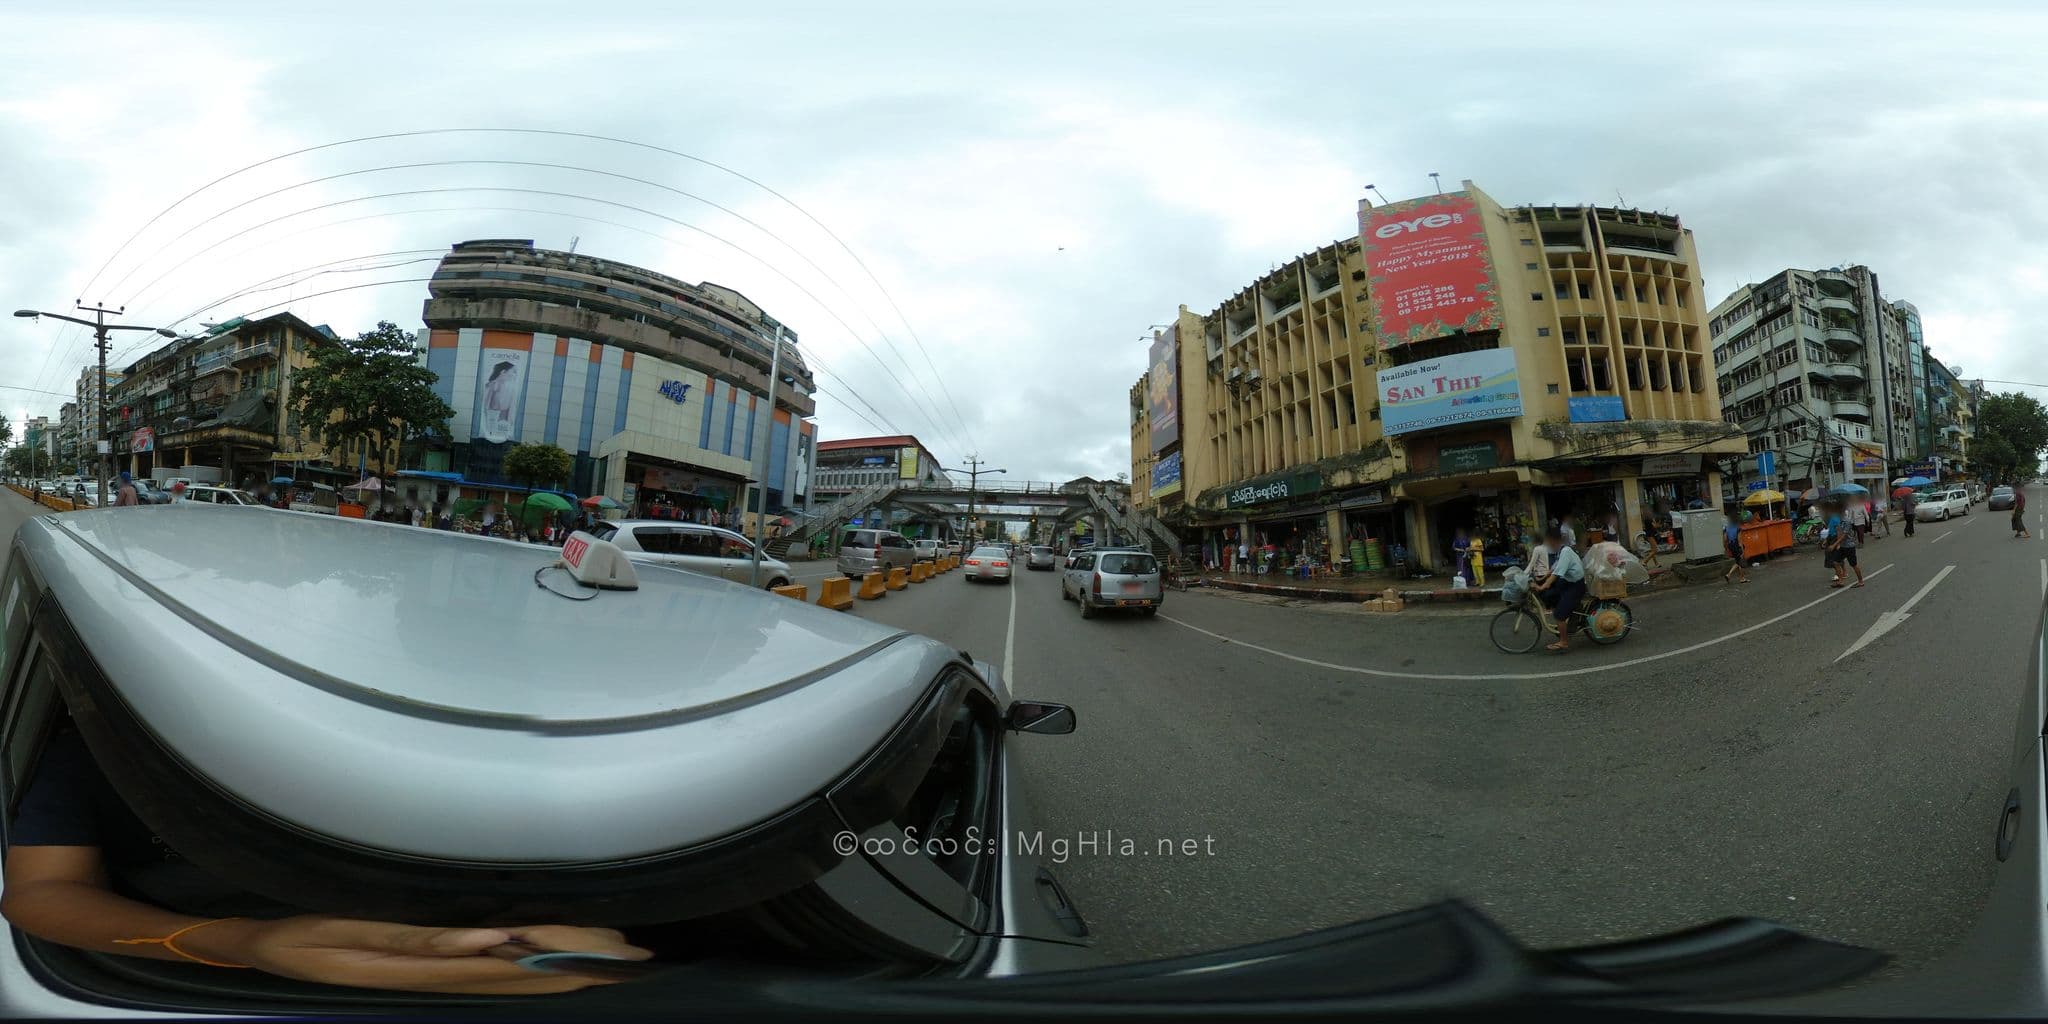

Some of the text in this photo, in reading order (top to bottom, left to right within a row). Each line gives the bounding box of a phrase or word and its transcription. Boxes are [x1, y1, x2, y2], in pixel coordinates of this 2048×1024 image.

[1376, 254, 1412, 268] Happy
[1416, 244, 1473, 259] Myanmar
[1385, 252, 1470, 274] New Year 2018
[1396, 294, 1408, 302] 01
[1397, 301, 1409, 309] 01
[1398, 308, 1411, 316] 09
[1413, 303, 1434, 312] 732
[1381, 363, 1441, 383] Available Now!
[563, 539, 588, 567] TAXI
